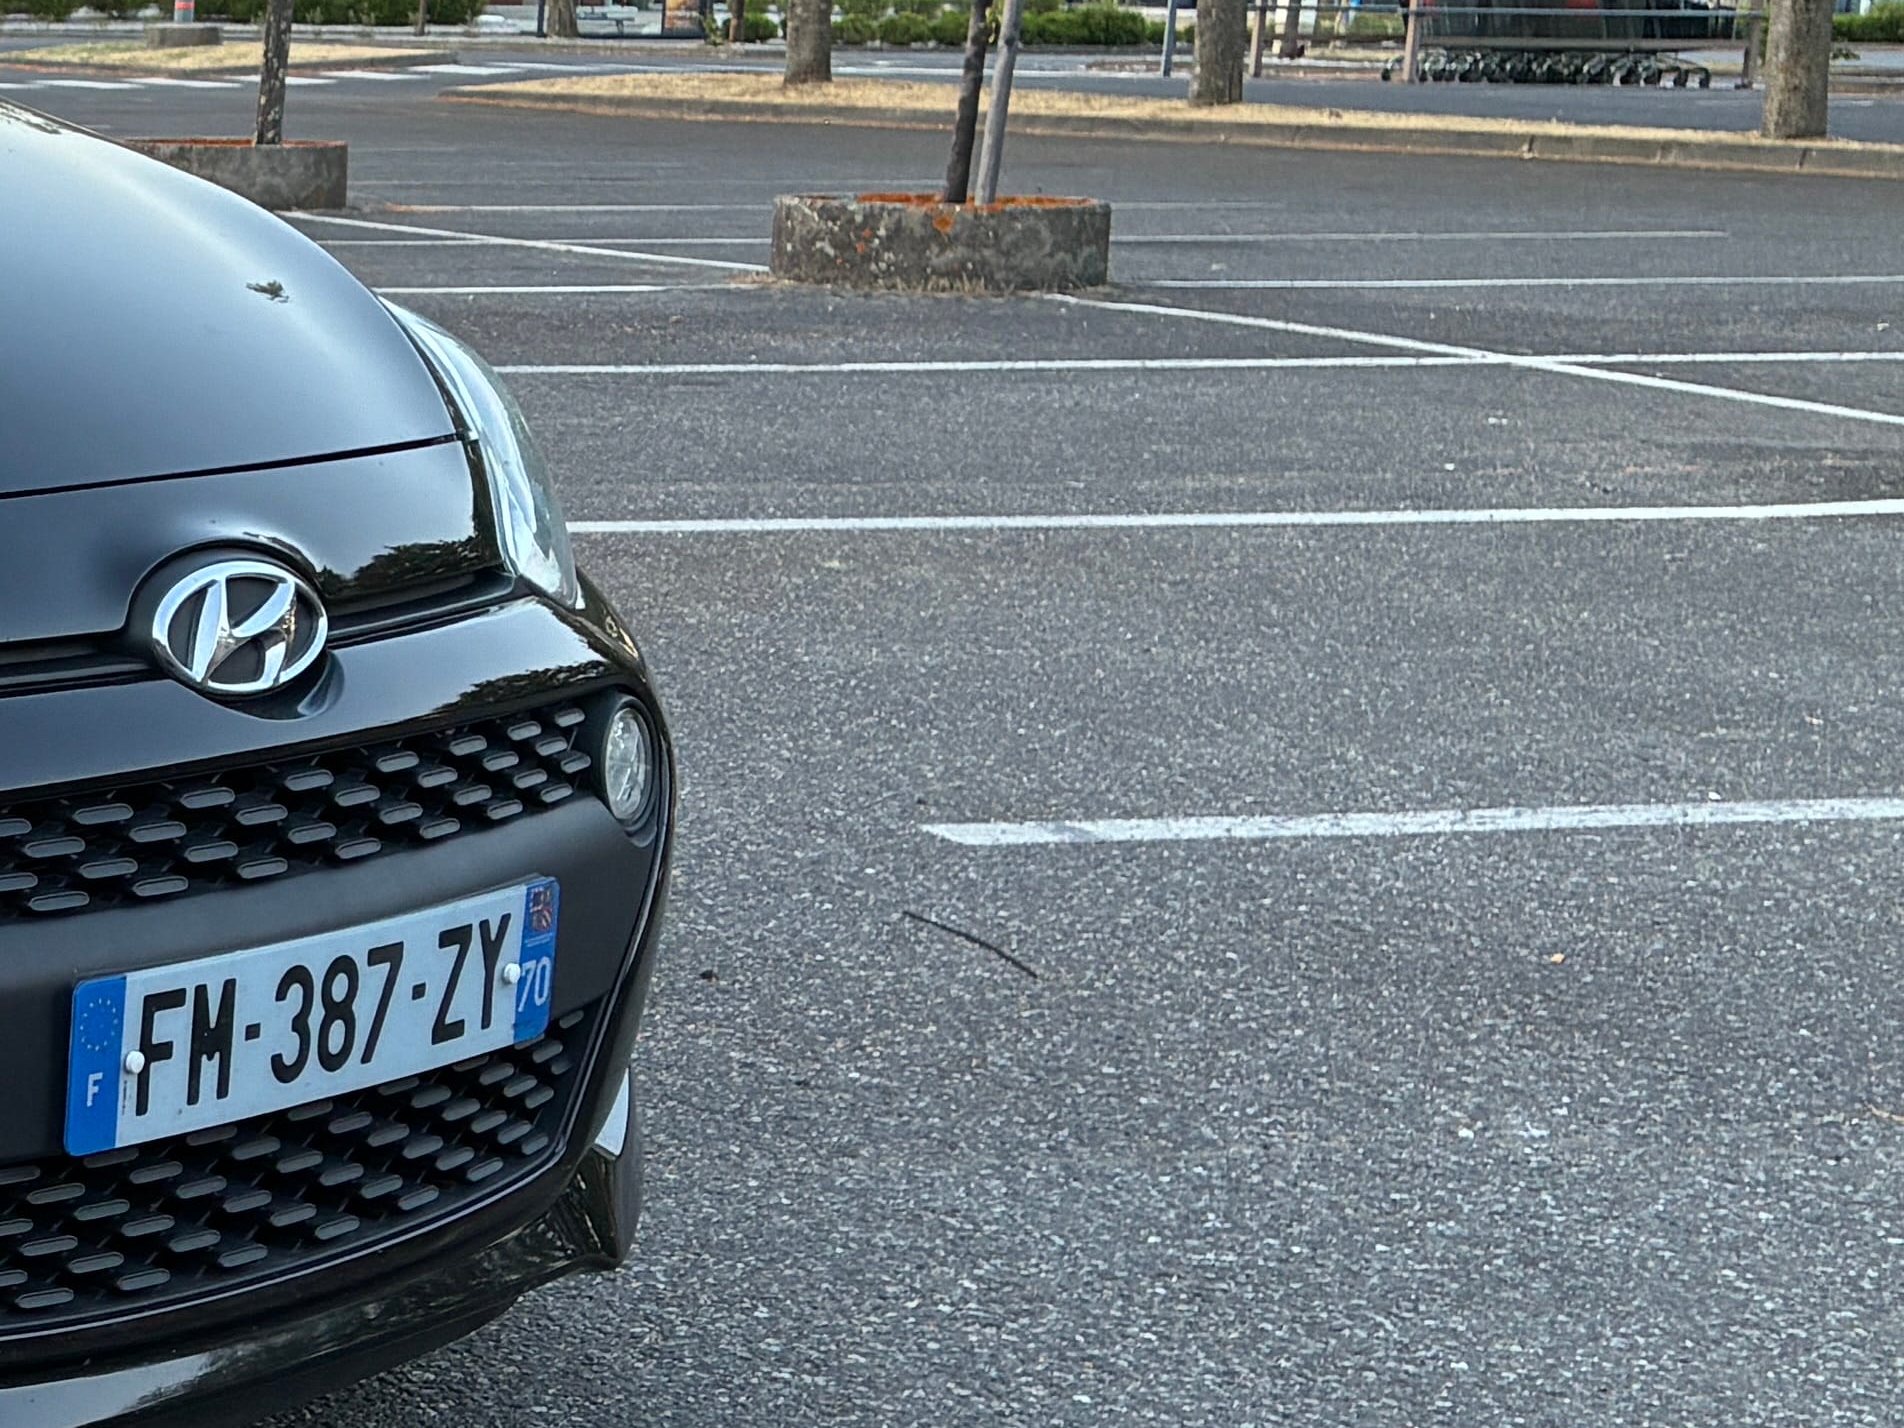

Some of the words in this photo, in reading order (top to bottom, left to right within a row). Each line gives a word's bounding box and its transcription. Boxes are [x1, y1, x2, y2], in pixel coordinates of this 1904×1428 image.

[517, 956, 552, 1013] 70
[134, 912, 512, 1117] FM-387-ZY
[86, 1071, 104, 1108] F
